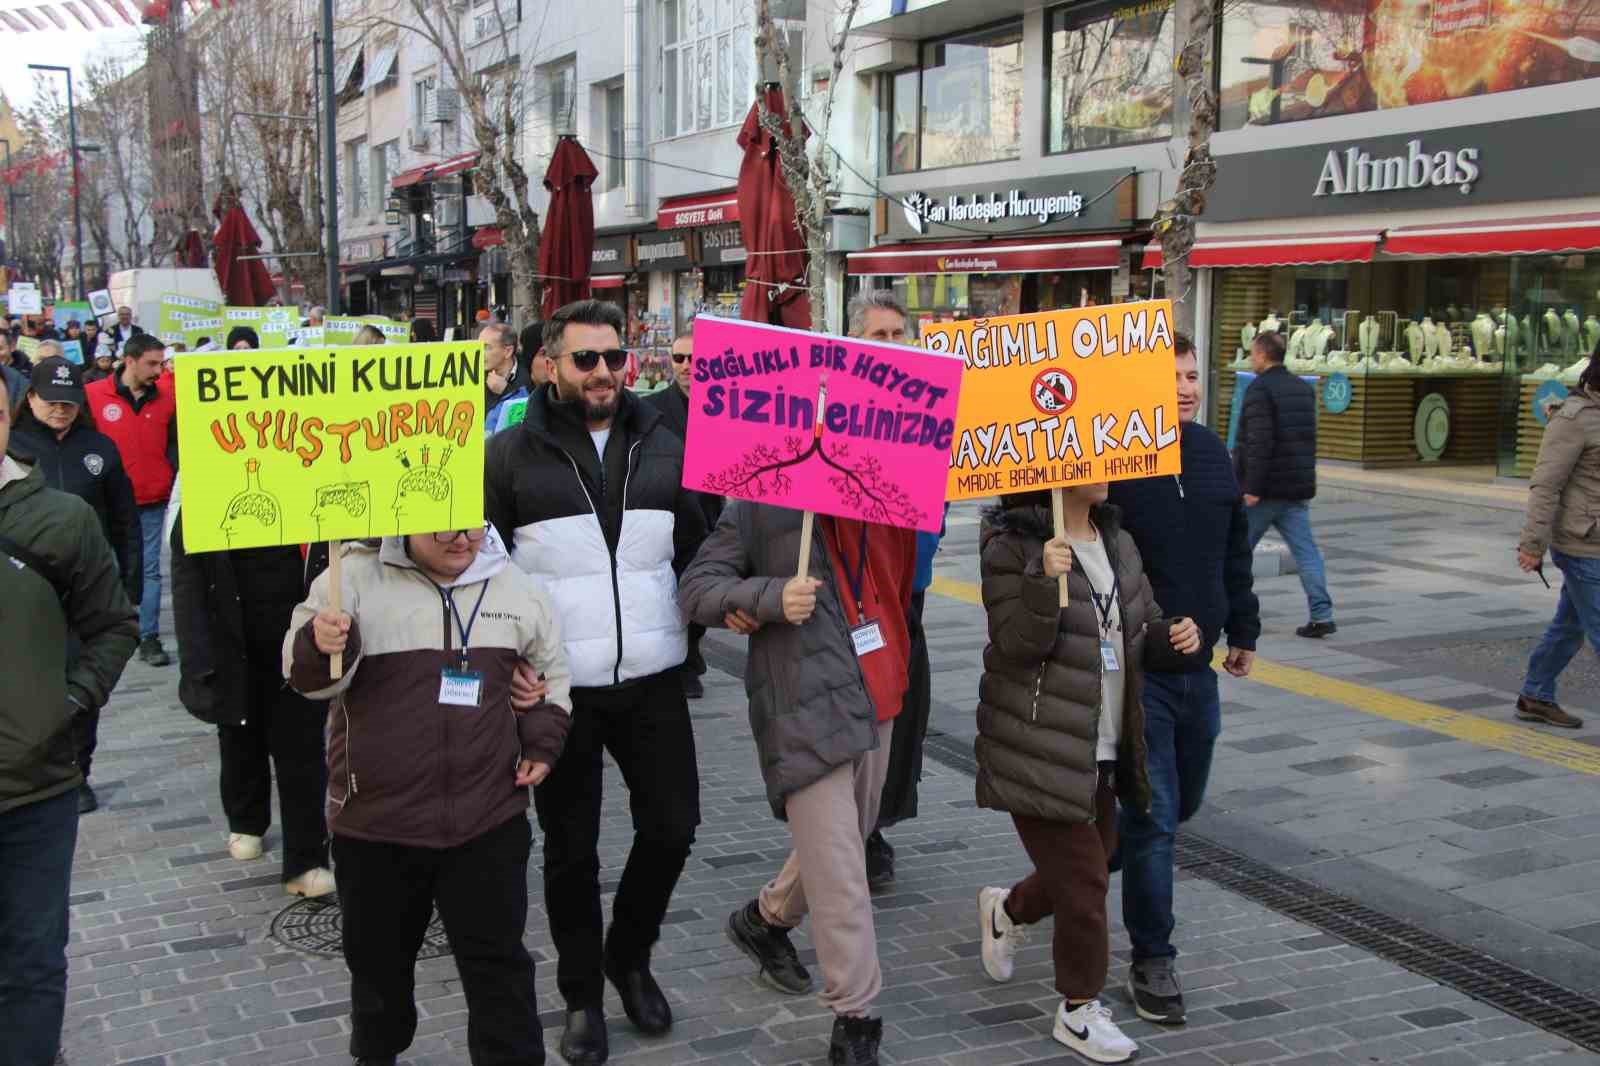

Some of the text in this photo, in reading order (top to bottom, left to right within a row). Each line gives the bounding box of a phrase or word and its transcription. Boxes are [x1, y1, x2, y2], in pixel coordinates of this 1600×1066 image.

[1312, 140, 1479, 194] Altınbaş
[809, 340, 848, 371] BİR
[1072, 309, 1173, 358] OLMA
[197, 350, 481, 402] BEYNİNİ KULLAN
[210, 399, 475, 467] UYUŞTURMA
[948, 406, 1177, 470] AYATTA KAL
[957, 472, 1003, 495] MADDE
[1104, 453, 1158, 477] HAYIR!!!
